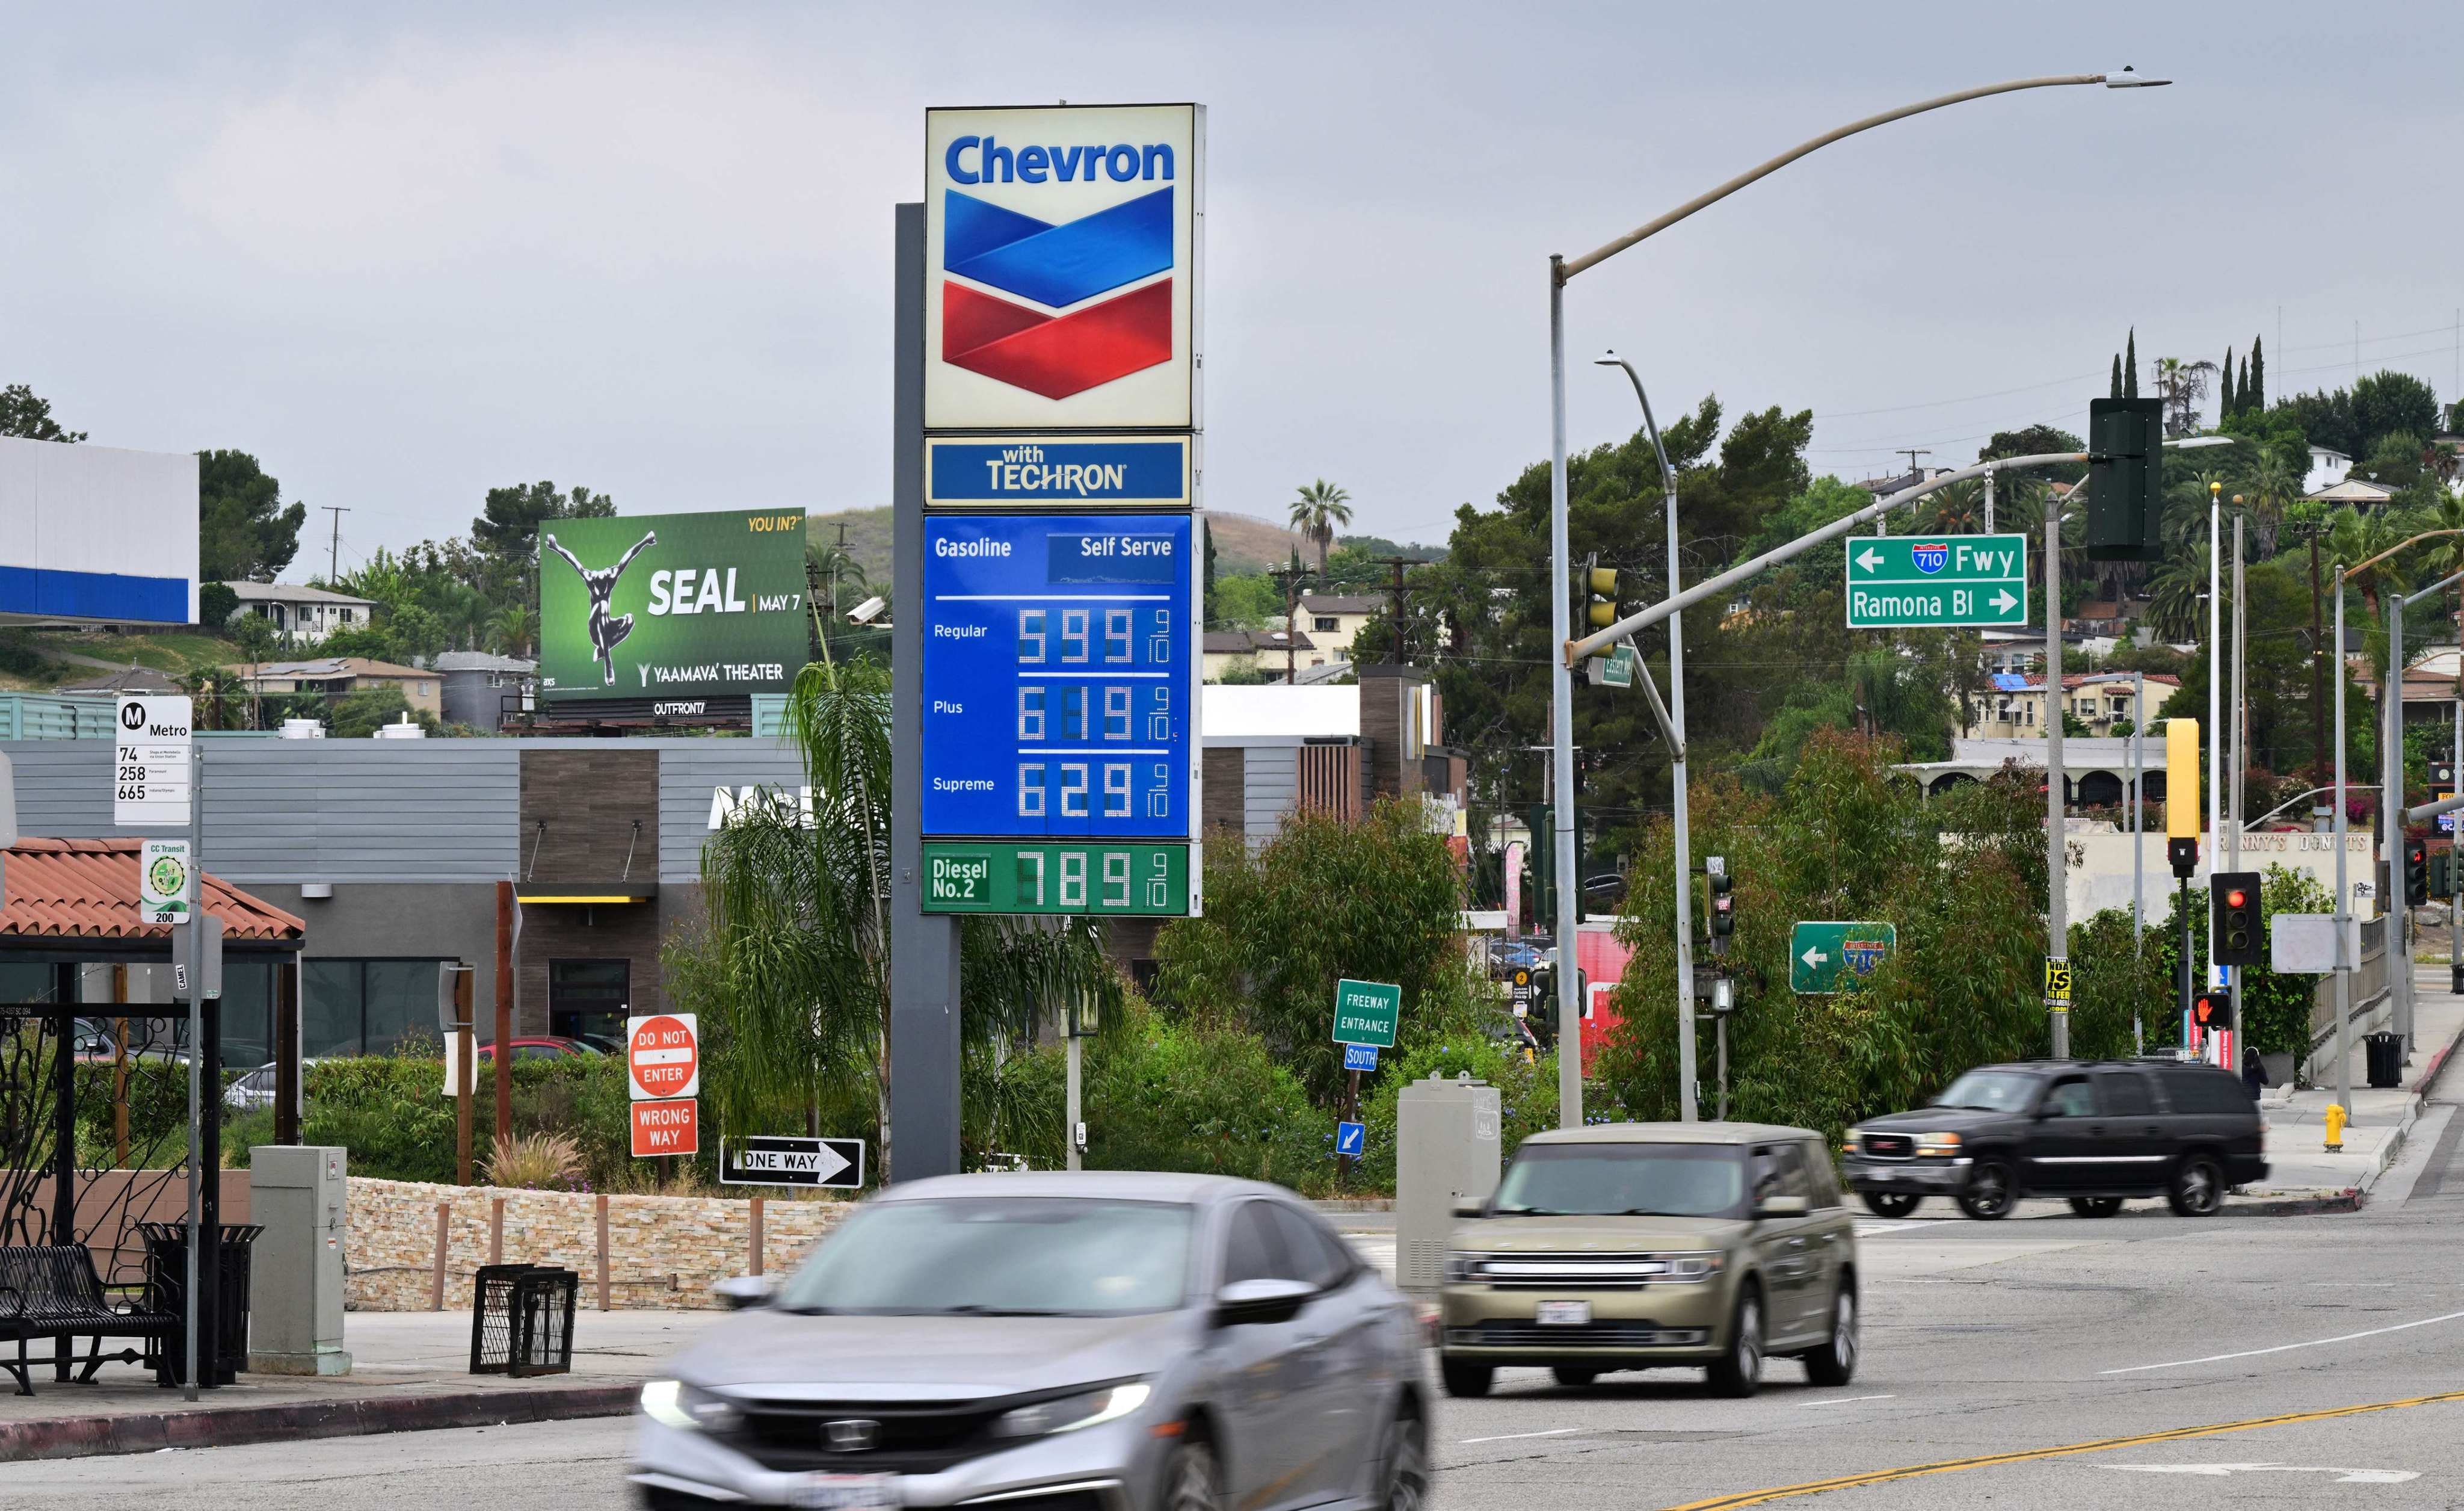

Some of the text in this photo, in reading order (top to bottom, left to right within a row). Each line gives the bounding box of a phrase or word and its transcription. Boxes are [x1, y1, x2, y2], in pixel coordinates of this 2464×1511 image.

[945, 134, 1174, 184] Chevron
[1002, 445, 1044, 462] with
[748, 516, 796, 532] YOU IN?
[935, 537, 1171, 557] Gasoline Self Serve
[1918, 545, 2015, 577] 710 Fwy
[647, 567, 801, 616] SEAL MAY 7
[1853, 590, 1973, 617] Ramona Bl
[934, 609, 1133, 663] Regular 599
[723, 663, 783, 681] THEATER
[1606, 655, 1624, 673] Eastern
[543, 678, 555, 687] axs
[934, 687, 1132, 740] Plus 619
[150, 725, 186, 736] Metro
[120, 747, 137, 761] 74
[119, 766, 146, 780] 258
[118, 785, 145, 800] 665
[933, 763, 1132, 817] Supreme 629
[933, 851, 1130, 906] Diesel 789
[156, 913, 174, 922] 200
[1347, 993, 1390, 1009] FREEWAY
[15, 1007, 22, 1015] SC
[1341, 1017, 1390, 1033] ENTRANCE
[638, 1030, 686, 1046] DO NOT
[1348, 1048, 1376, 1066] SOUTH
[644, 1068, 683, 1083] ENTER
[639, 1108, 690, 1126] WRONG
[650, 1129, 680, 1146] WAY
[745, 1153, 818, 1169] ONE WAY
